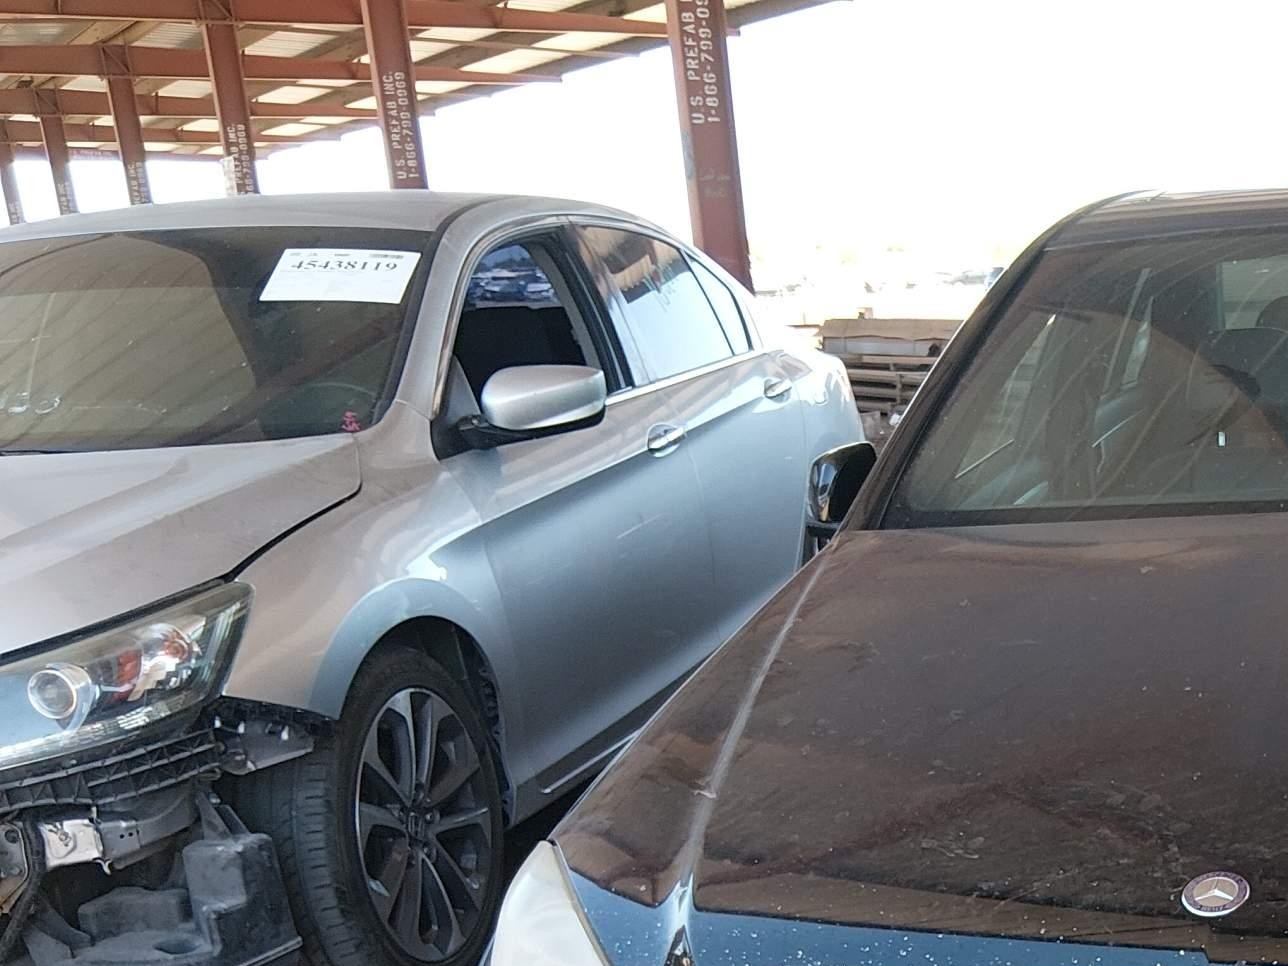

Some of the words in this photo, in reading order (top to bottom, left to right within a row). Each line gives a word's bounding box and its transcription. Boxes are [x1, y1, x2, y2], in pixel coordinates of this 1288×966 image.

[681, 12, 701, 81] PREFAB
[382, 72, 395, 95] INC.
[386, 101, 402, 149] PREFAB
[290, 260, 398, 271] 45438119
